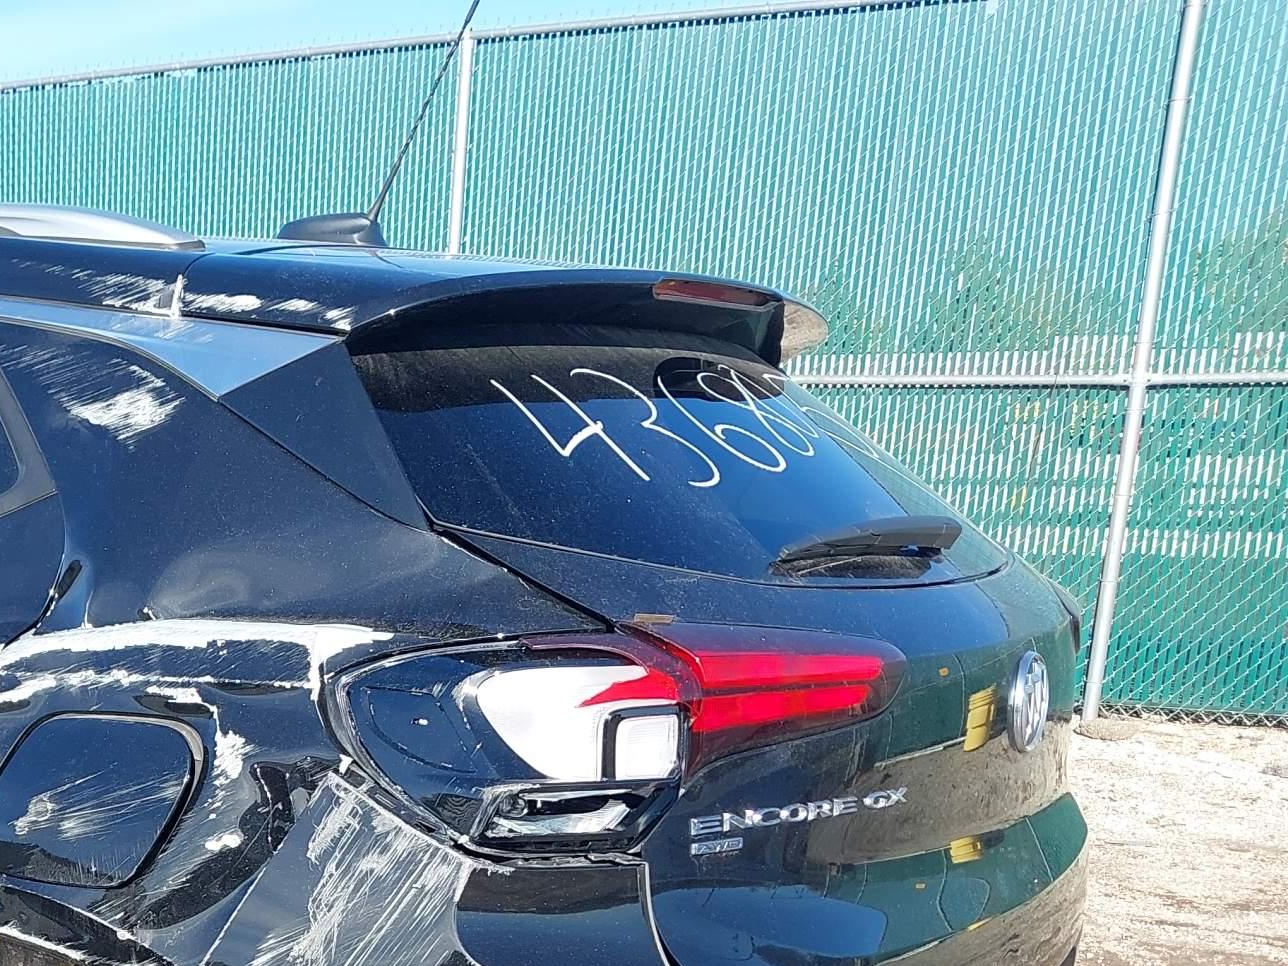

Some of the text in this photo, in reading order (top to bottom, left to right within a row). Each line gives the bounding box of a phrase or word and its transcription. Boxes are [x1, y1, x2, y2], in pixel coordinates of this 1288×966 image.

[690, 786, 908, 836] ENCORE GX
[693, 838, 742, 854] AWD
